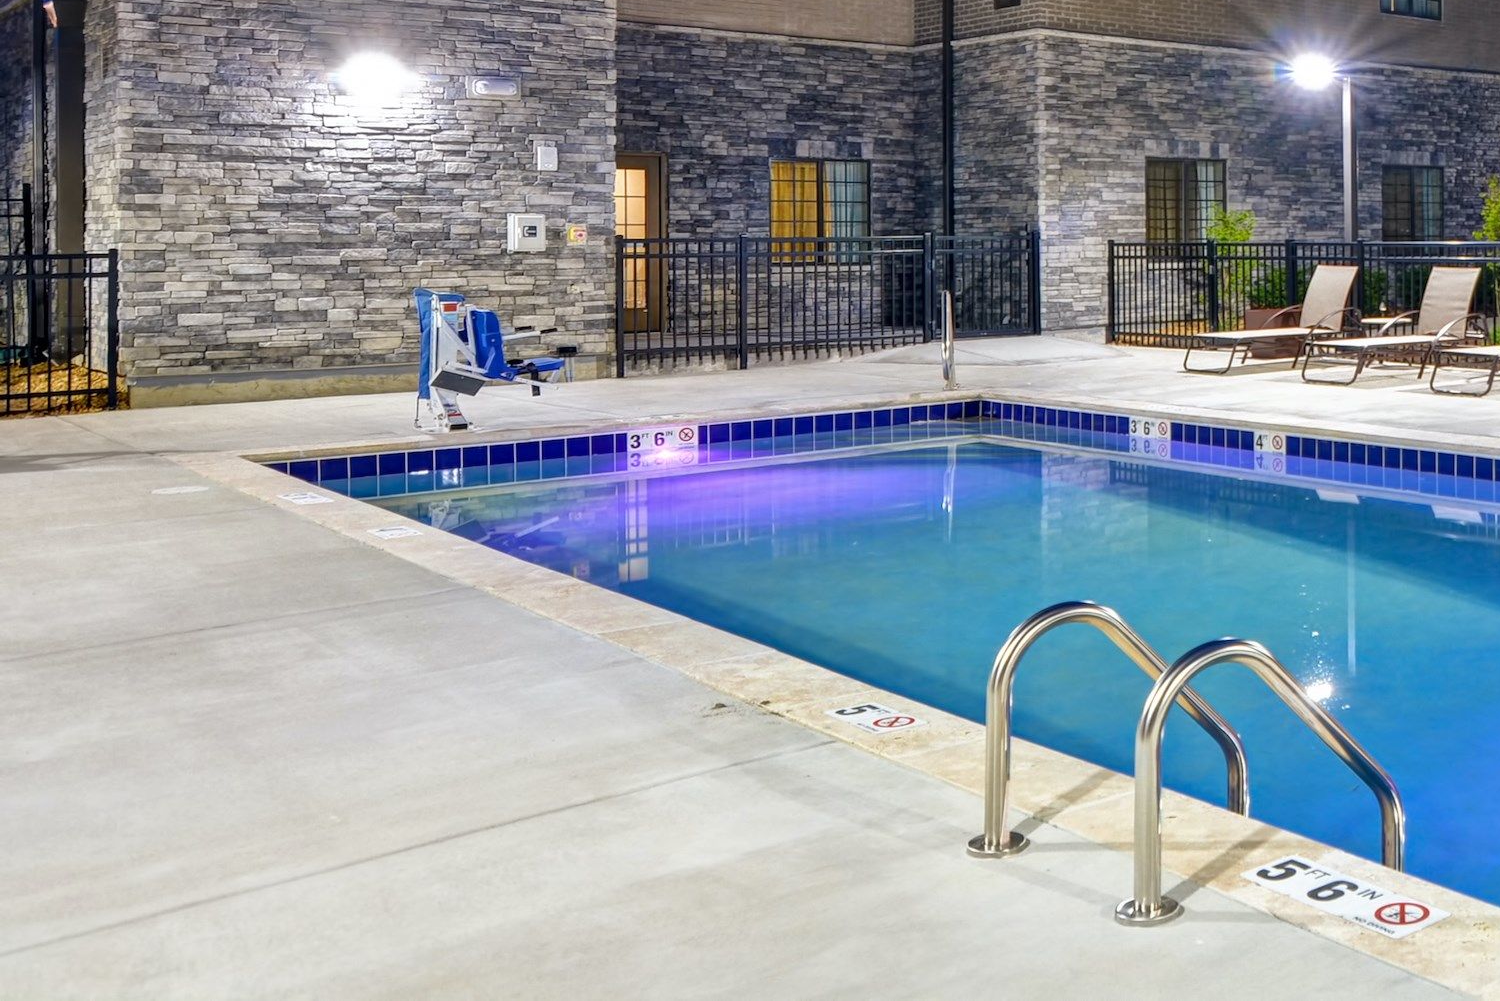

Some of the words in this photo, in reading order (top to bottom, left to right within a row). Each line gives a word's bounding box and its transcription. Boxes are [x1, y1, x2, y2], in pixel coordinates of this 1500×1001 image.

[1131, 420, 1137, 433] 3
[1143, 421, 1150, 435] 6
[630, 435, 641, 449] 3
[654, 432, 665, 447] 6
[1256, 434, 1263, 450] 4
[835, 704, 880, 716] 5
[1256, 859, 1311, 881] 5
[1304, 869, 1332, 880] FT
[1306, 880, 1359, 902] 6
[1358, 888, 1384, 900] IN
